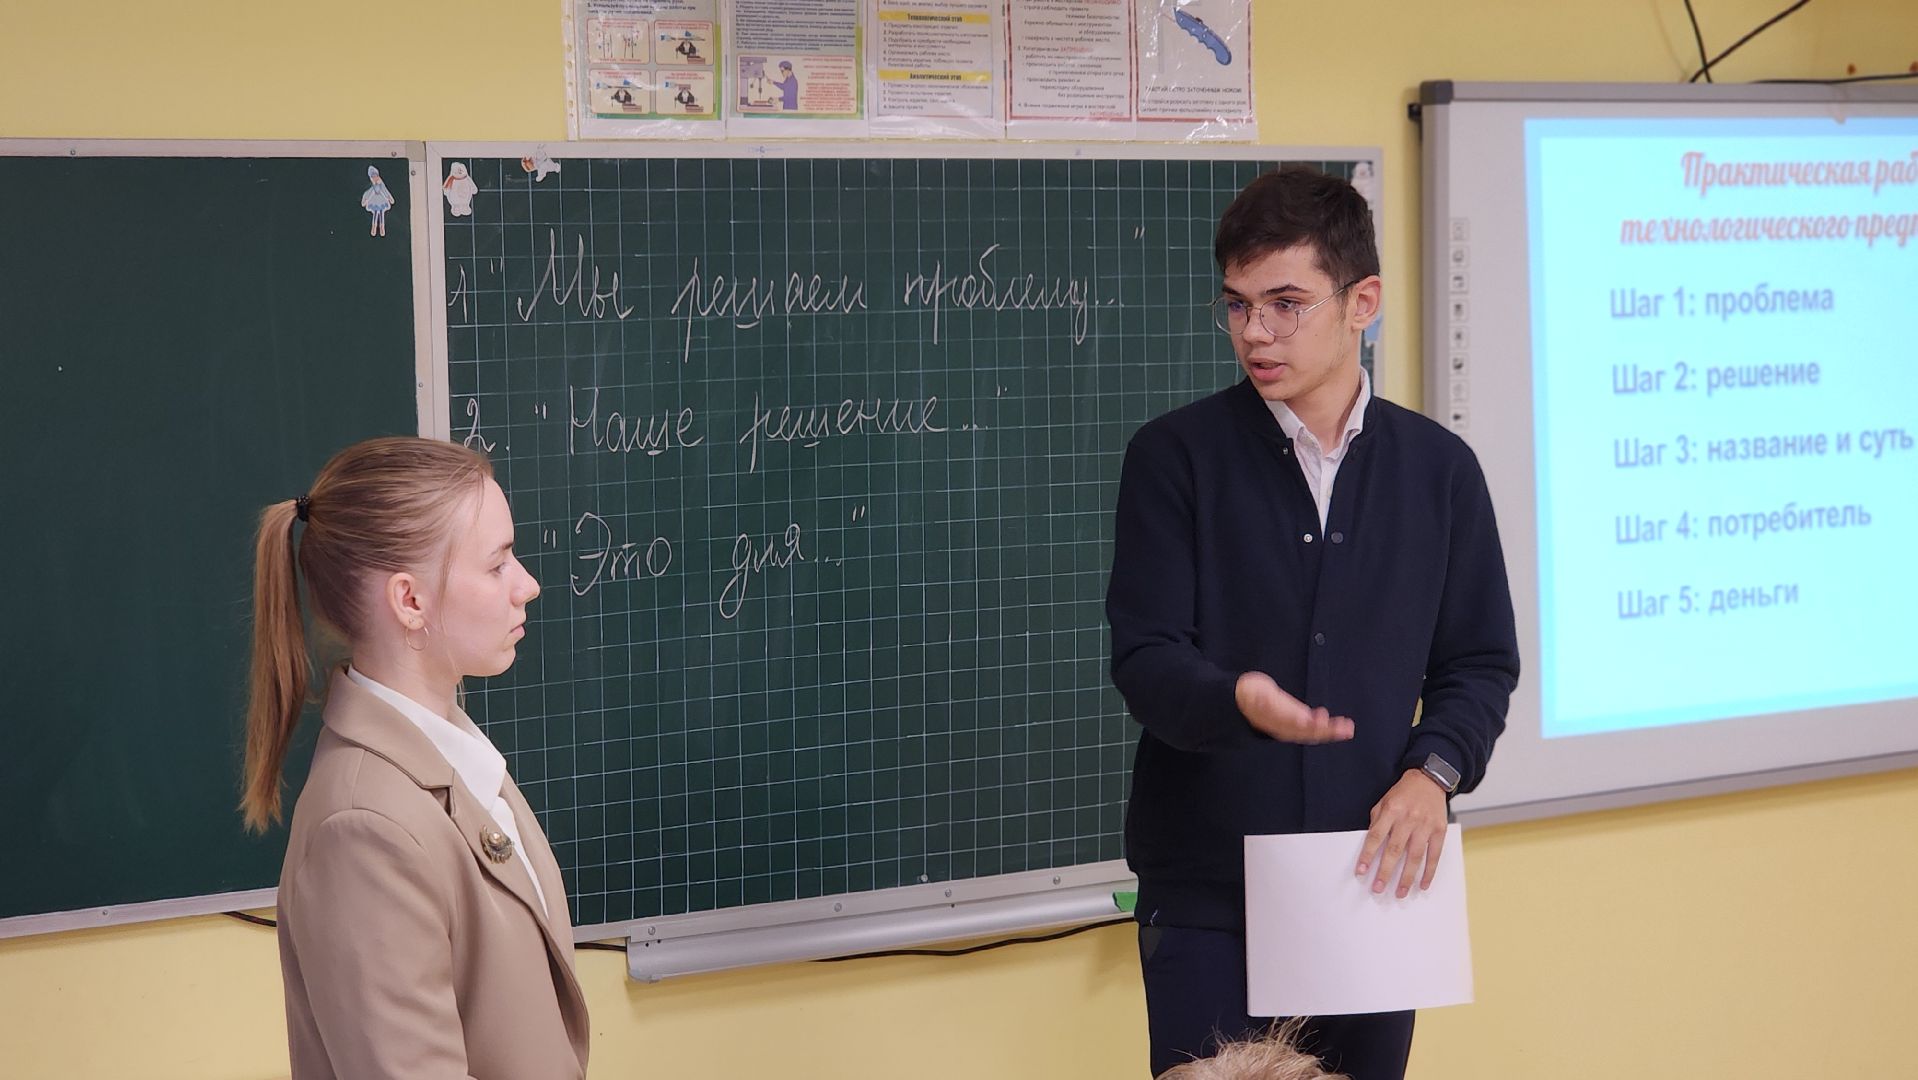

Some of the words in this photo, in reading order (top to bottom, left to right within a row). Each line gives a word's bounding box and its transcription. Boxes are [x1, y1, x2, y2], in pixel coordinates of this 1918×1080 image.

[1681, 151, 1870, 198] Практическая
[1620, 214, 1850, 244] технологического
[671, 257, 868, 363] решаем
[1610, 287, 1663, 318] Шаг
[1673, 285, 1695, 317] 1:
[1705, 282, 1834, 322] проблема
[1612, 363, 1665, 394] Шаг
[1675, 361, 1697, 391] 2:
[1706, 361, 1820, 397] решение
[1614, 438, 1667, 468] Шаг
[1675, 434, 1697, 464] 3:
[1707, 432, 1828, 462] название
[1836, 432, 1850, 454] и
[1859, 427, 1914, 459] суть
[1615, 514, 1668, 544] Шаг
[1676, 510, 1698, 539] 4:
[1708, 502, 1871, 541] потребитель
[1618, 590, 1670, 619] Шаг
[1678, 585, 1700, 614] 5:
[1708, 583, 1799, 615] деньги
